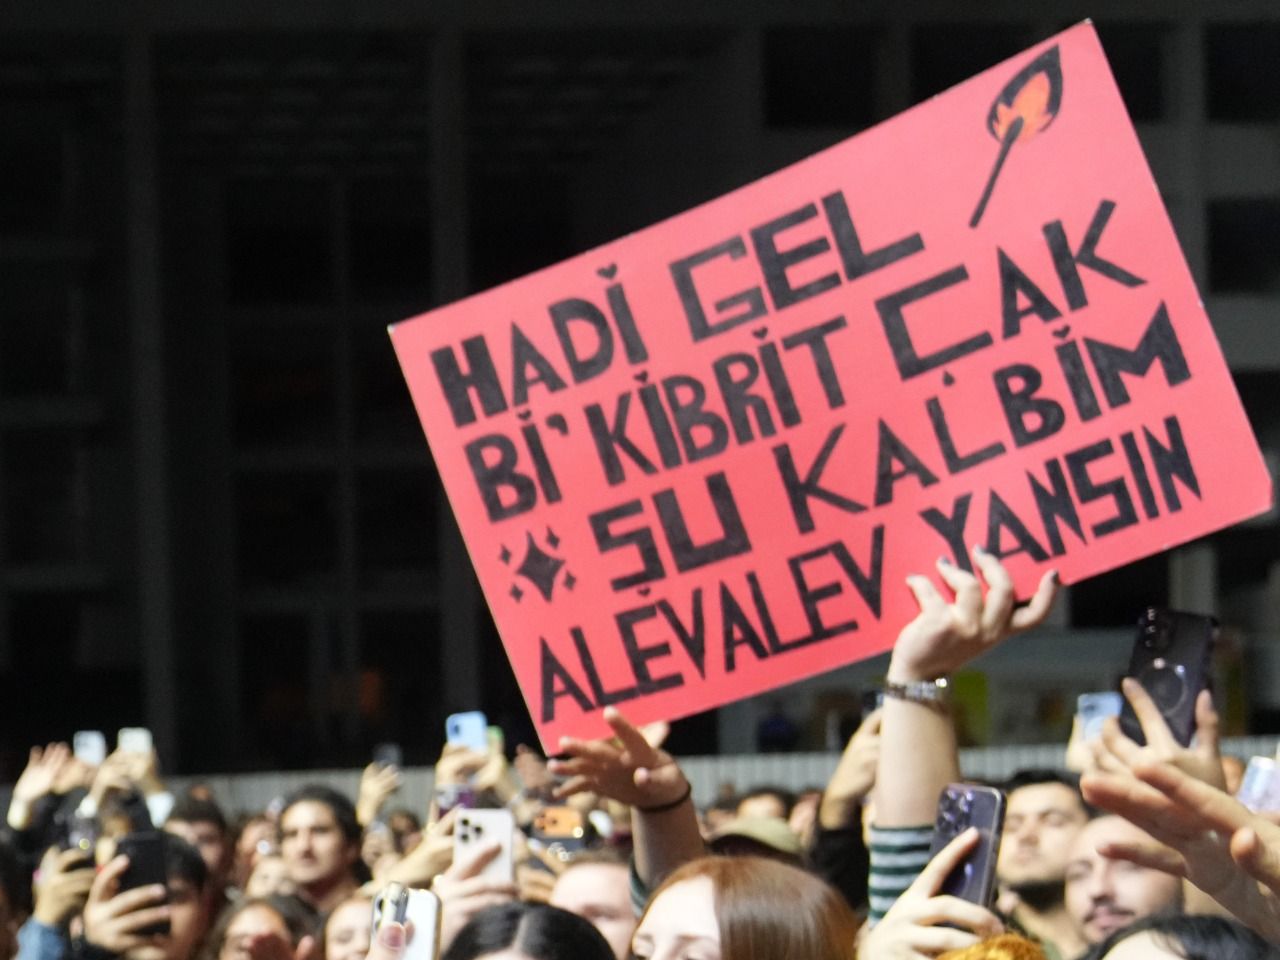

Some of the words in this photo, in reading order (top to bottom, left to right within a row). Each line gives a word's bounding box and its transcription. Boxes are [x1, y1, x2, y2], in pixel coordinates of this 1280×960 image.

[430, 263, 649, 428] HADİ
[669, 189, 925, 343] GEL
[583, 314, 848, 487] KİBRİT
[874, 198, 1148, 387] ÇAK
[772, 300, 1192, 535] KALBİM
[918, 414, 1202, 577] YANSIN
